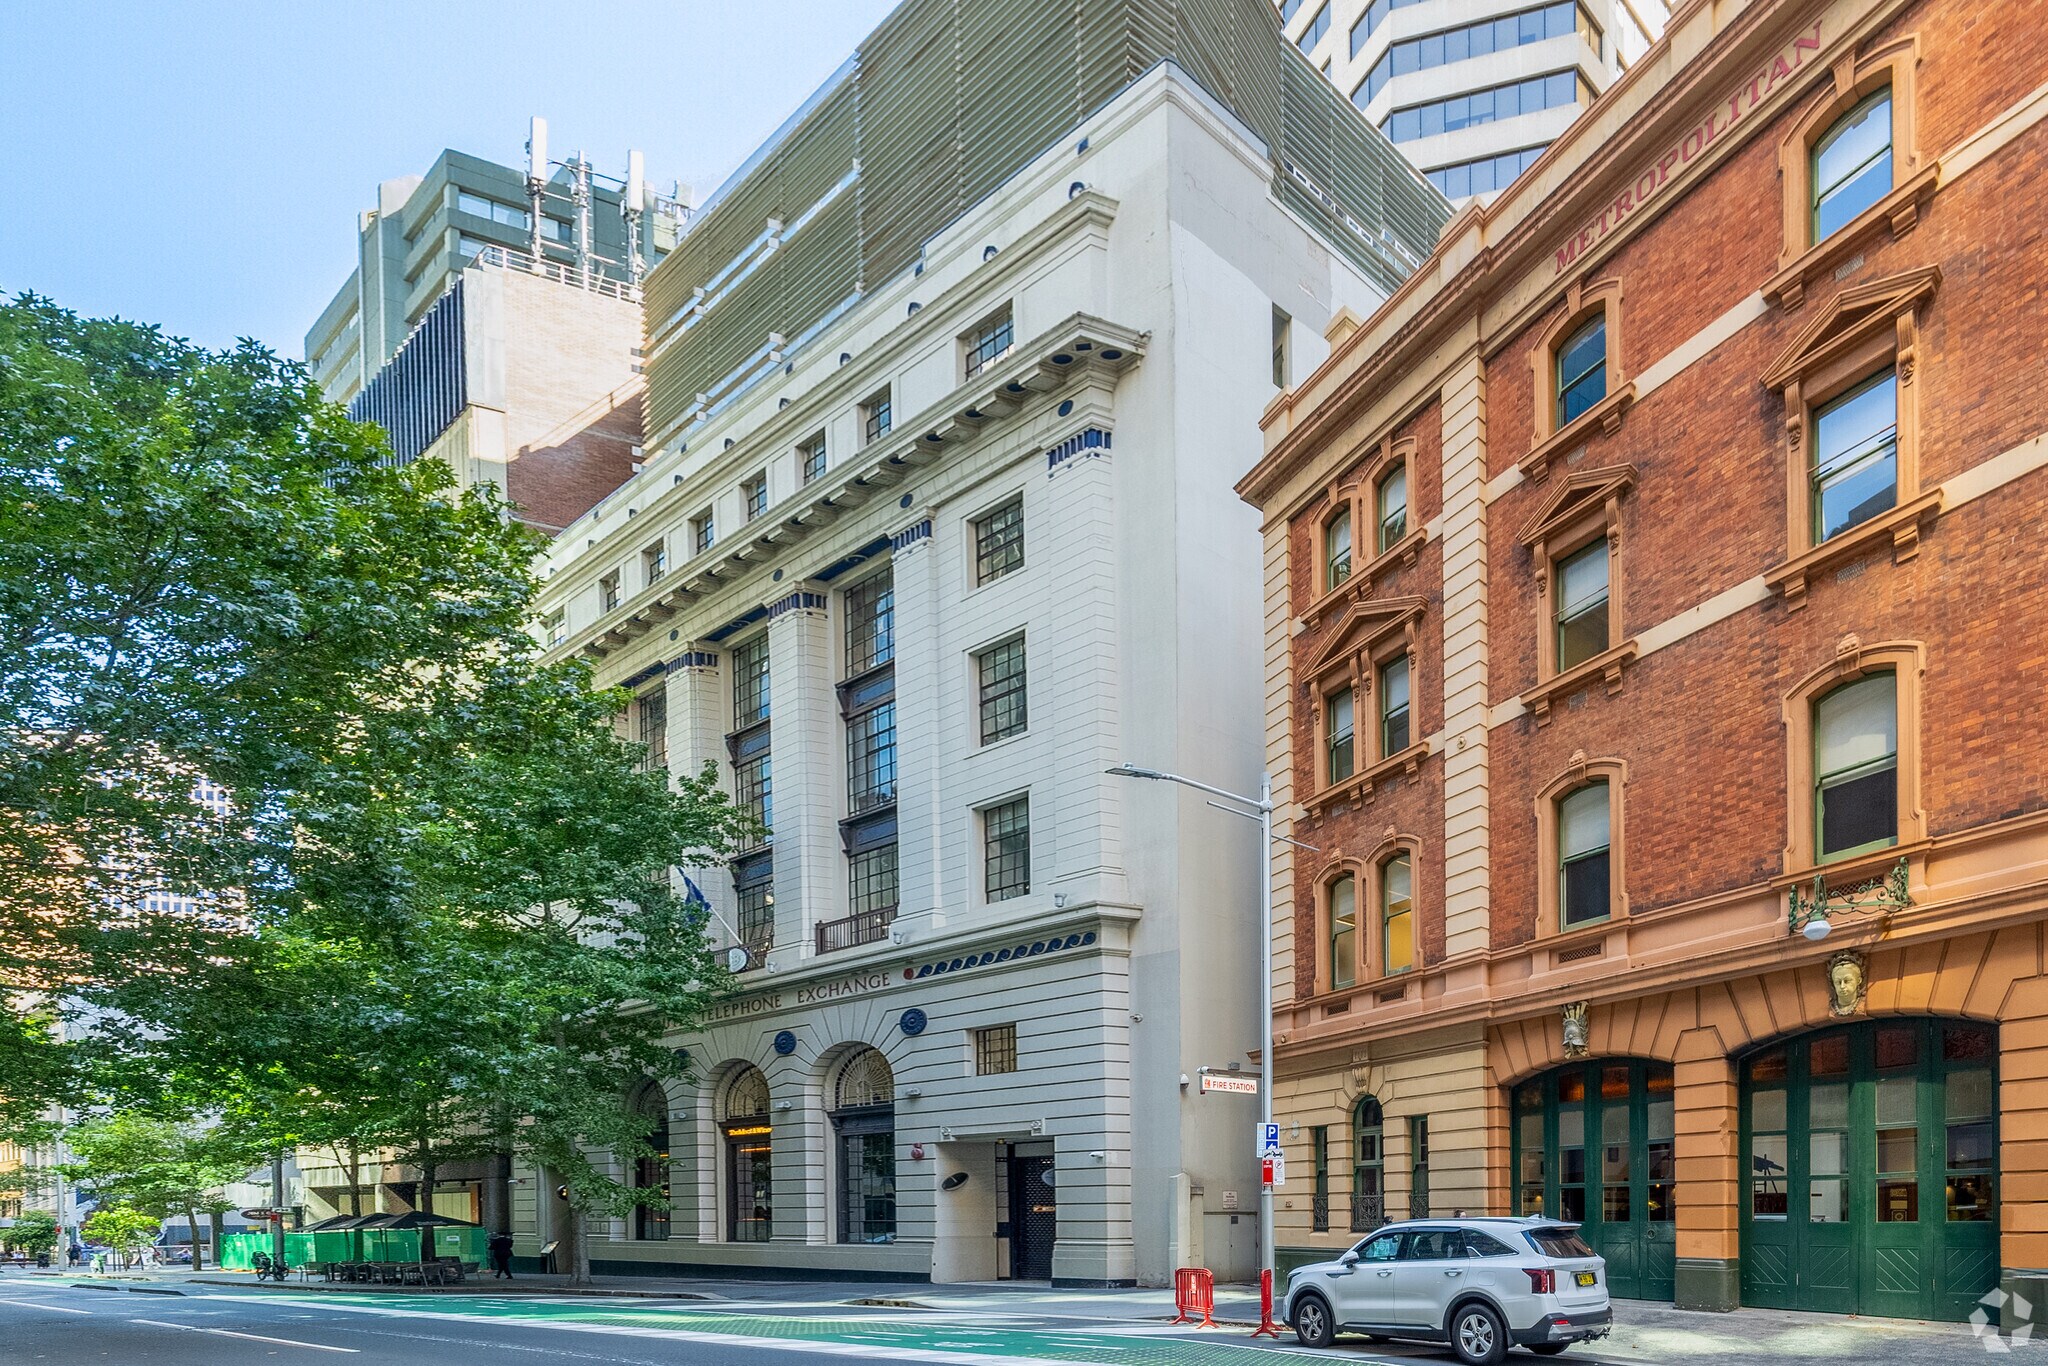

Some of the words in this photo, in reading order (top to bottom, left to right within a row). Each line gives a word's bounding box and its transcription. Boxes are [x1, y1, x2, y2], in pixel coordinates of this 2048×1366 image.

[1555, 21, 1822, 275] METROPOLITAN
[700, 994, 782, 1022] TELEPHONE
[797, 972, 891, 1004] EXCHANGE
[1212, 1081, 1227, 1089] FIRE
[1229, 1082, 1256, 1092] STATION
[1268, 1126, 1276, 1138] P
